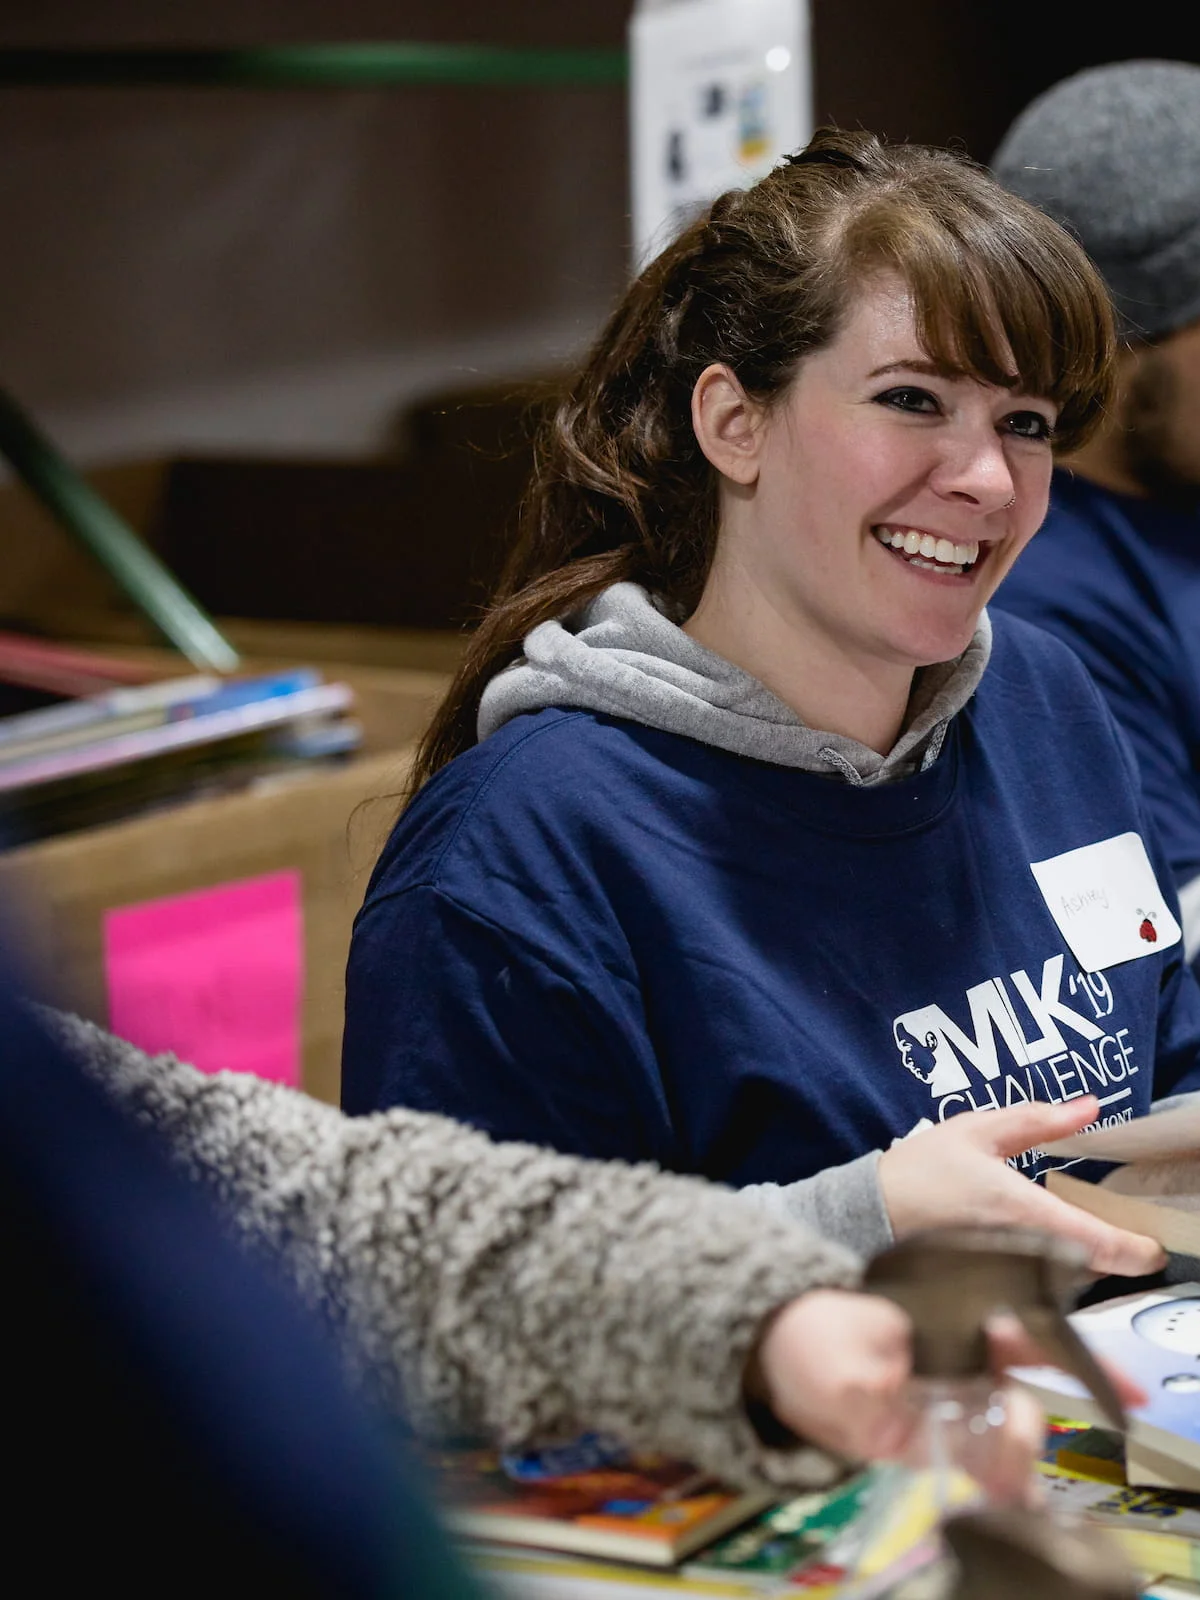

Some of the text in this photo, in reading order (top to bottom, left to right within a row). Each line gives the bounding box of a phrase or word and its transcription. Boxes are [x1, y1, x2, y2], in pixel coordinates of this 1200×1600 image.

[1060, 887, 1110, 920] Ashley
[893, 954, 1105, 1098] MLK
[937, 1028, 1139, 1122] CHALLENGE
